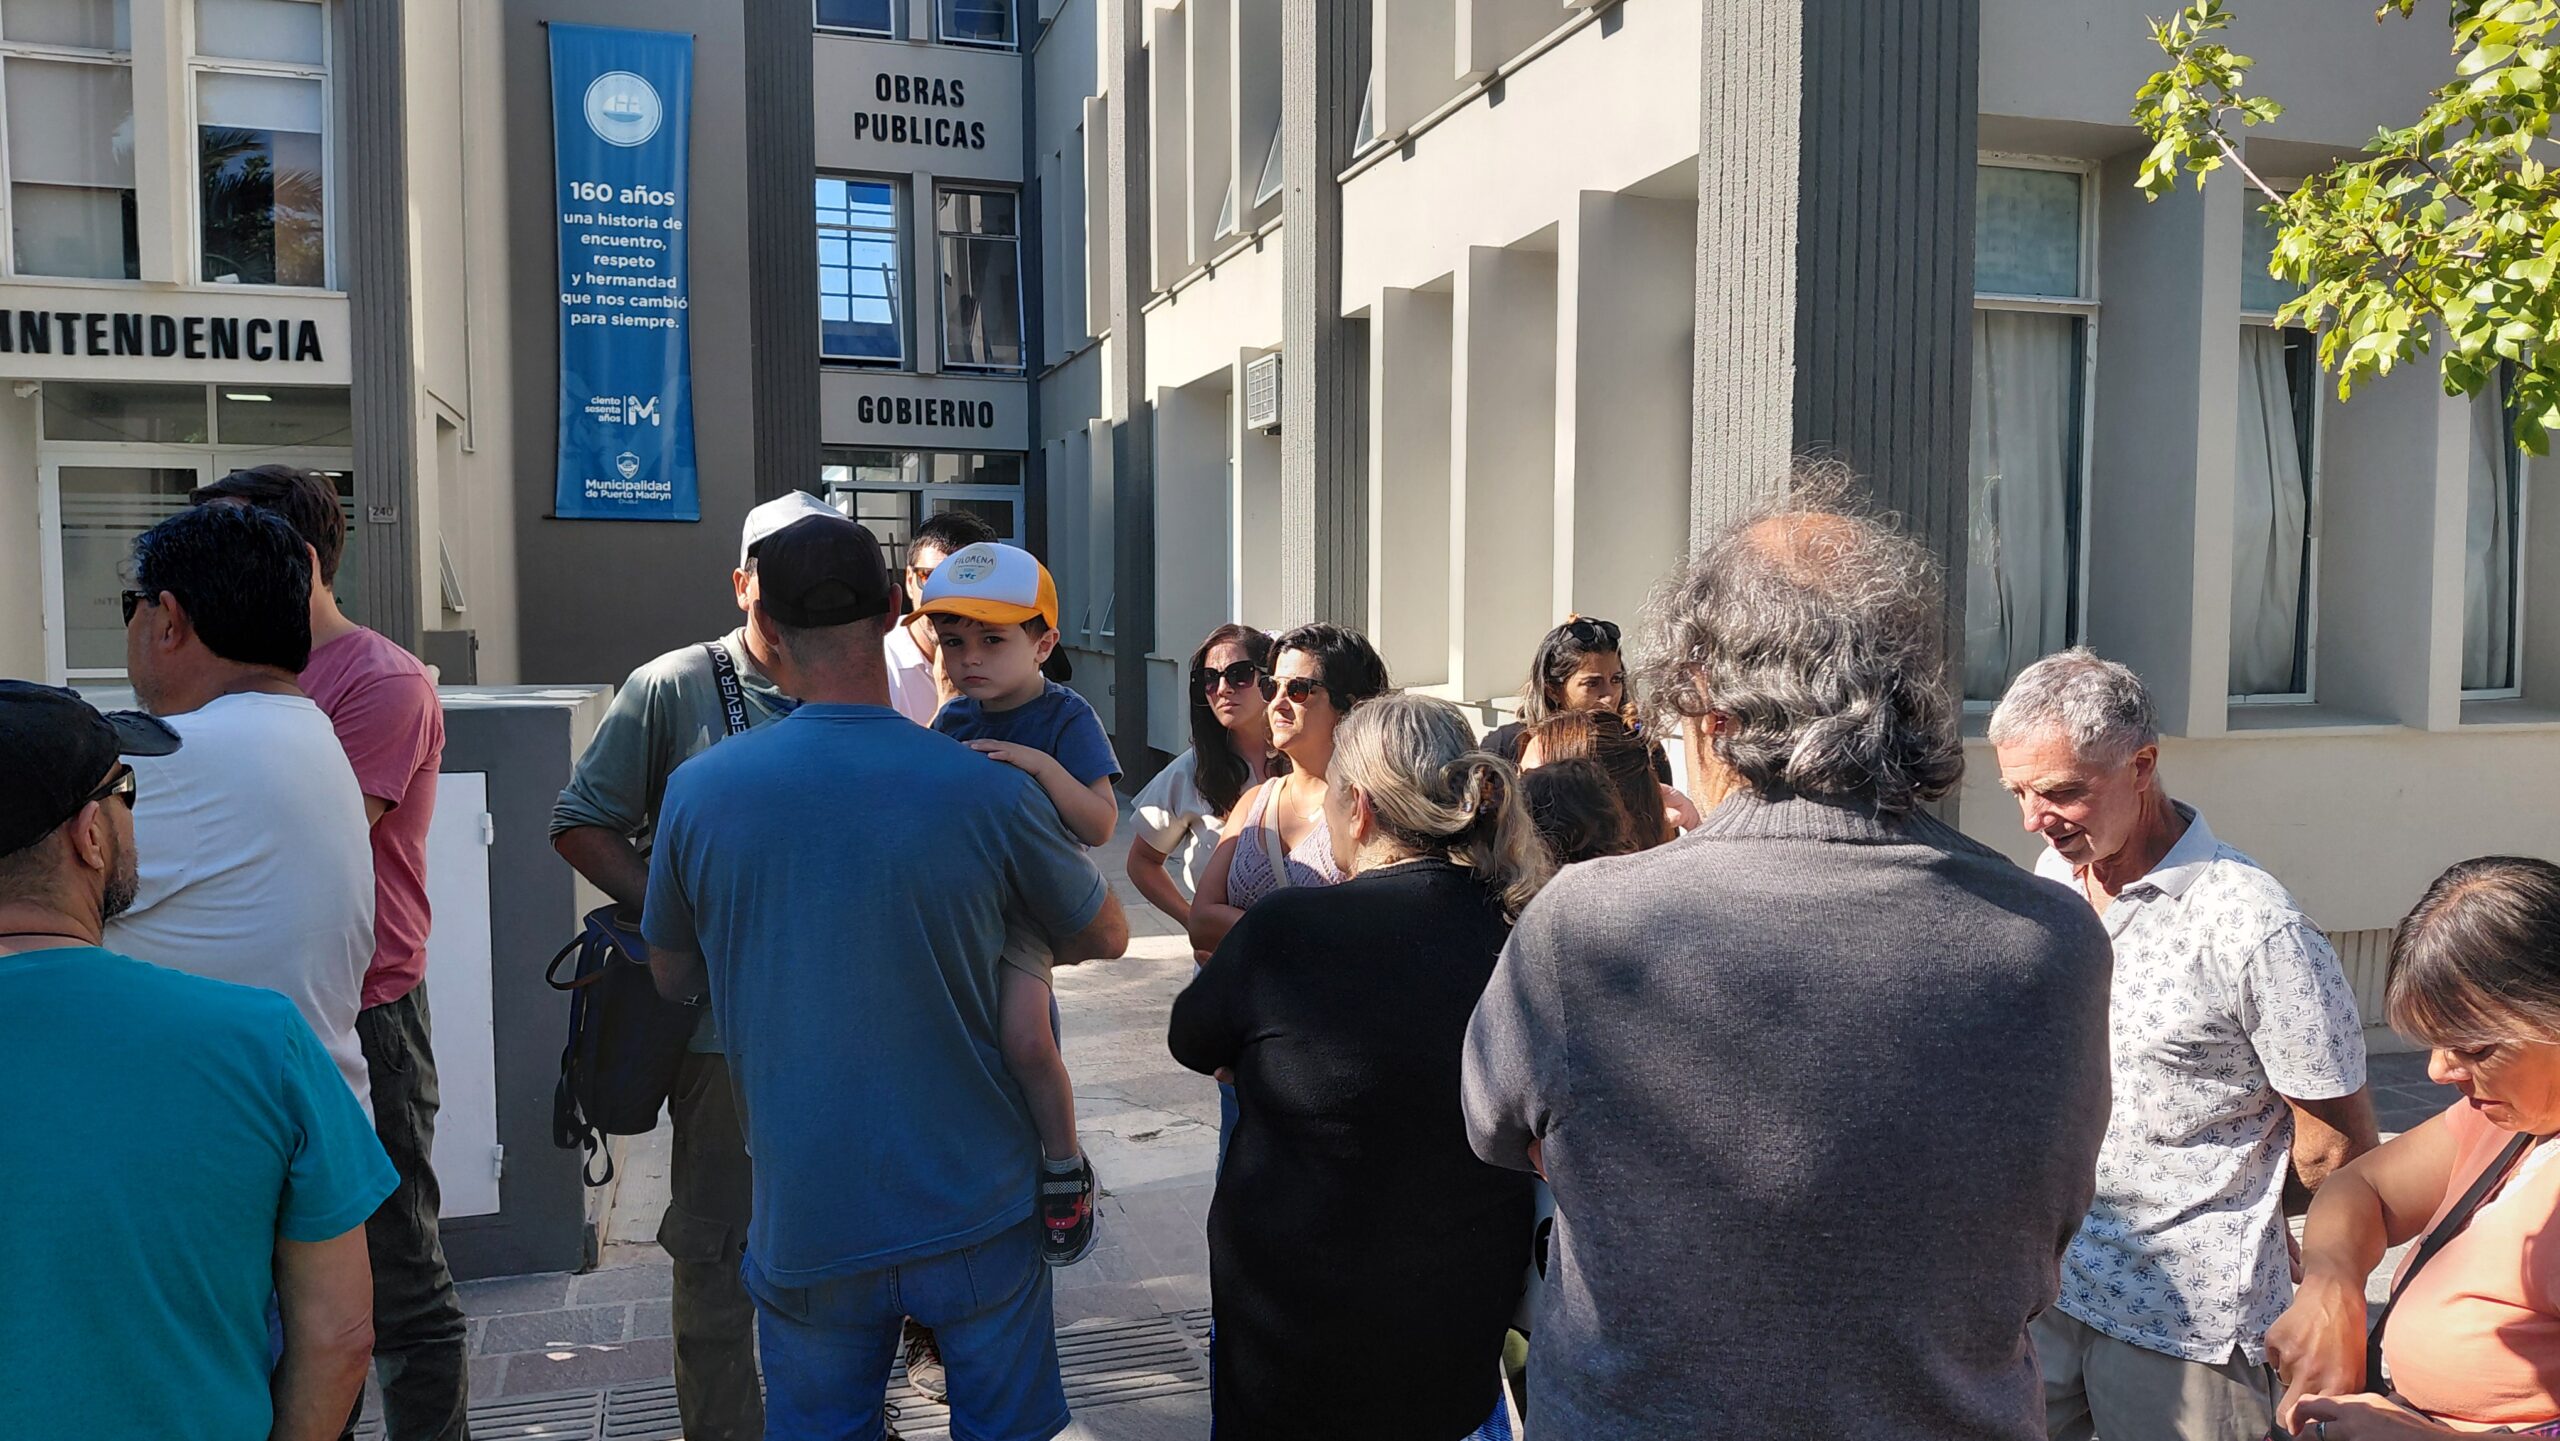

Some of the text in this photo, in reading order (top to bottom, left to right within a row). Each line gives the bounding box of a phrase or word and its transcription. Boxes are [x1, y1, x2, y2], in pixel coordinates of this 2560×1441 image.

[875, 72, 965, 108] OBRAS
[854, 112, 985, 150] PUBLICAS
[570, 181, 675, 206] 160 años
[563, 213, 683, 231] una historia de
[580, 233, 667, 251] encuentro,
[593, 254, 656, 269] respeto
[571, 272, 677, 289] y hermandad
[561, 292, 688, 310] que nos cambió
[571, 313, 680, 330] para siempre.
[0, 309, 324, 362] INTENDENCIA
[590, 395, 621, 405] ciento
[584, 405, 621, 414] sesenta
[598, 413, 621, 423] años
[858, 395, 994, 428] GOBIERNO
[585, 479, 672, 492] Municipalidad
[584, 489, 672, 501] de Puerto Madryn
[372, 506, 394, 517] 240
